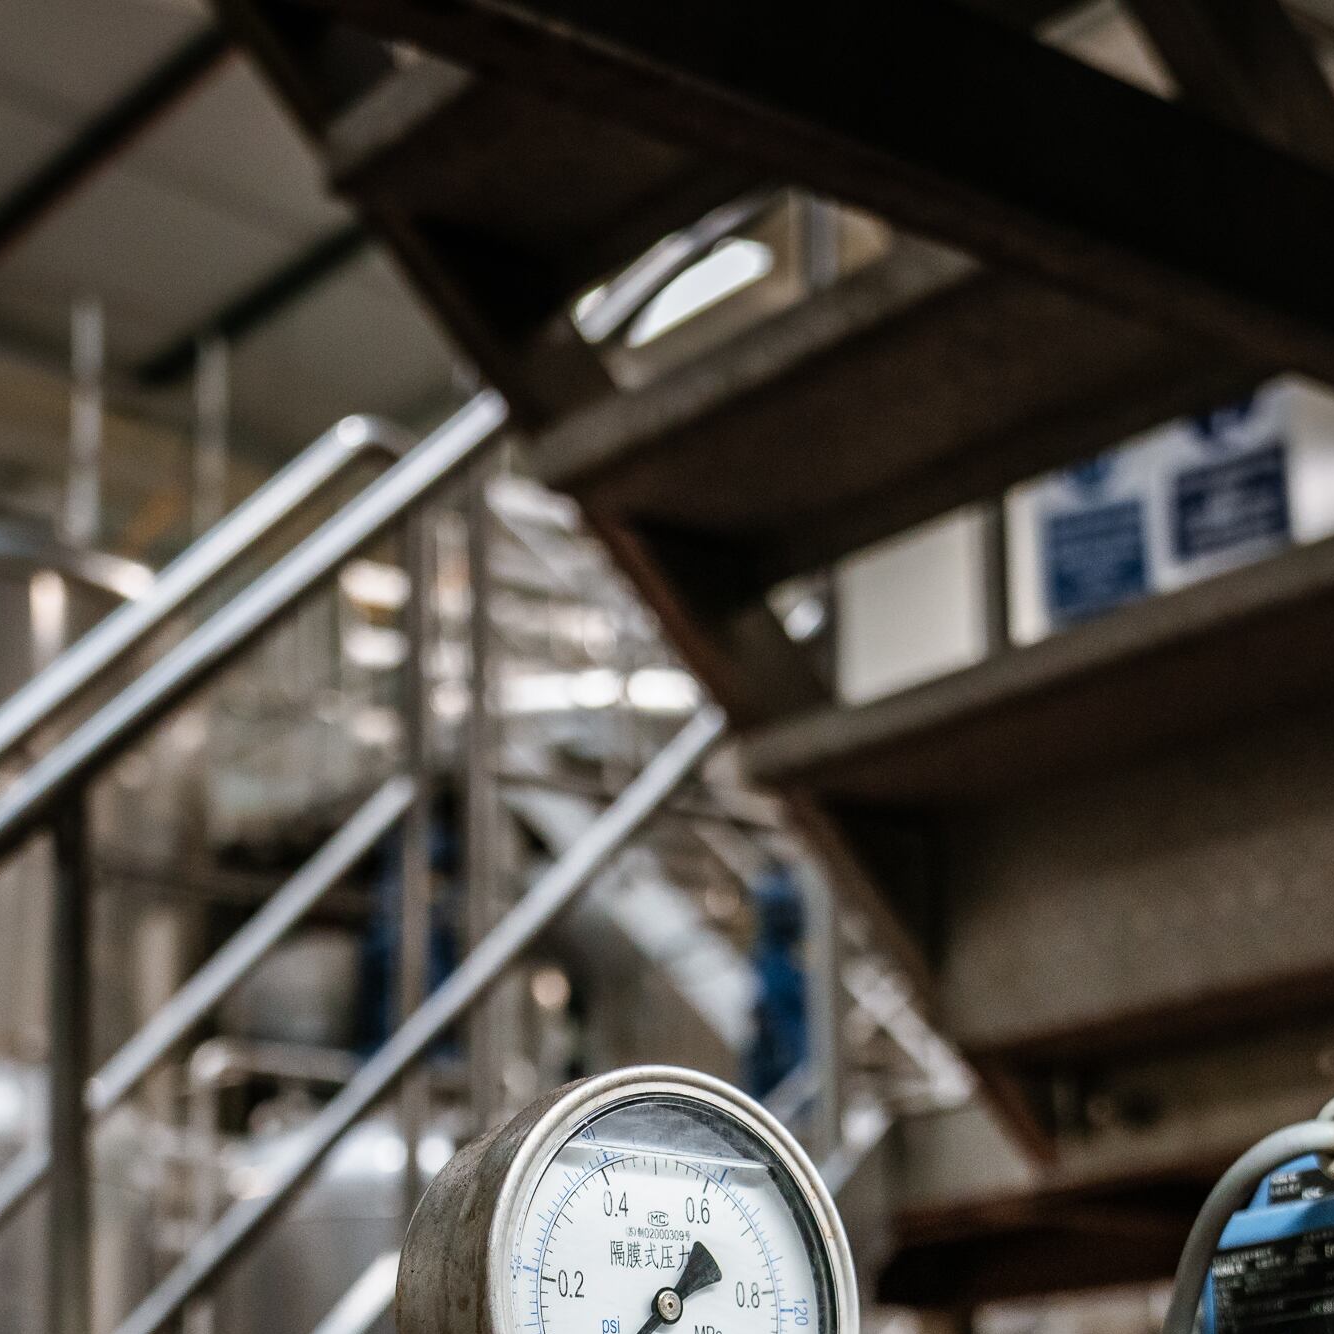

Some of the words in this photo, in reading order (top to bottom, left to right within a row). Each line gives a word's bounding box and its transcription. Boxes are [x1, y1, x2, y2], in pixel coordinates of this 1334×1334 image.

[603, 1190, 629, 1217] 0.4
[686, 1197, 710, 1224] 0.6
[558, 1269, 585, 1298] 0.2
[736, 1281, 760, 1308] 0.8
[794, 1298, 809, 1327] 120
